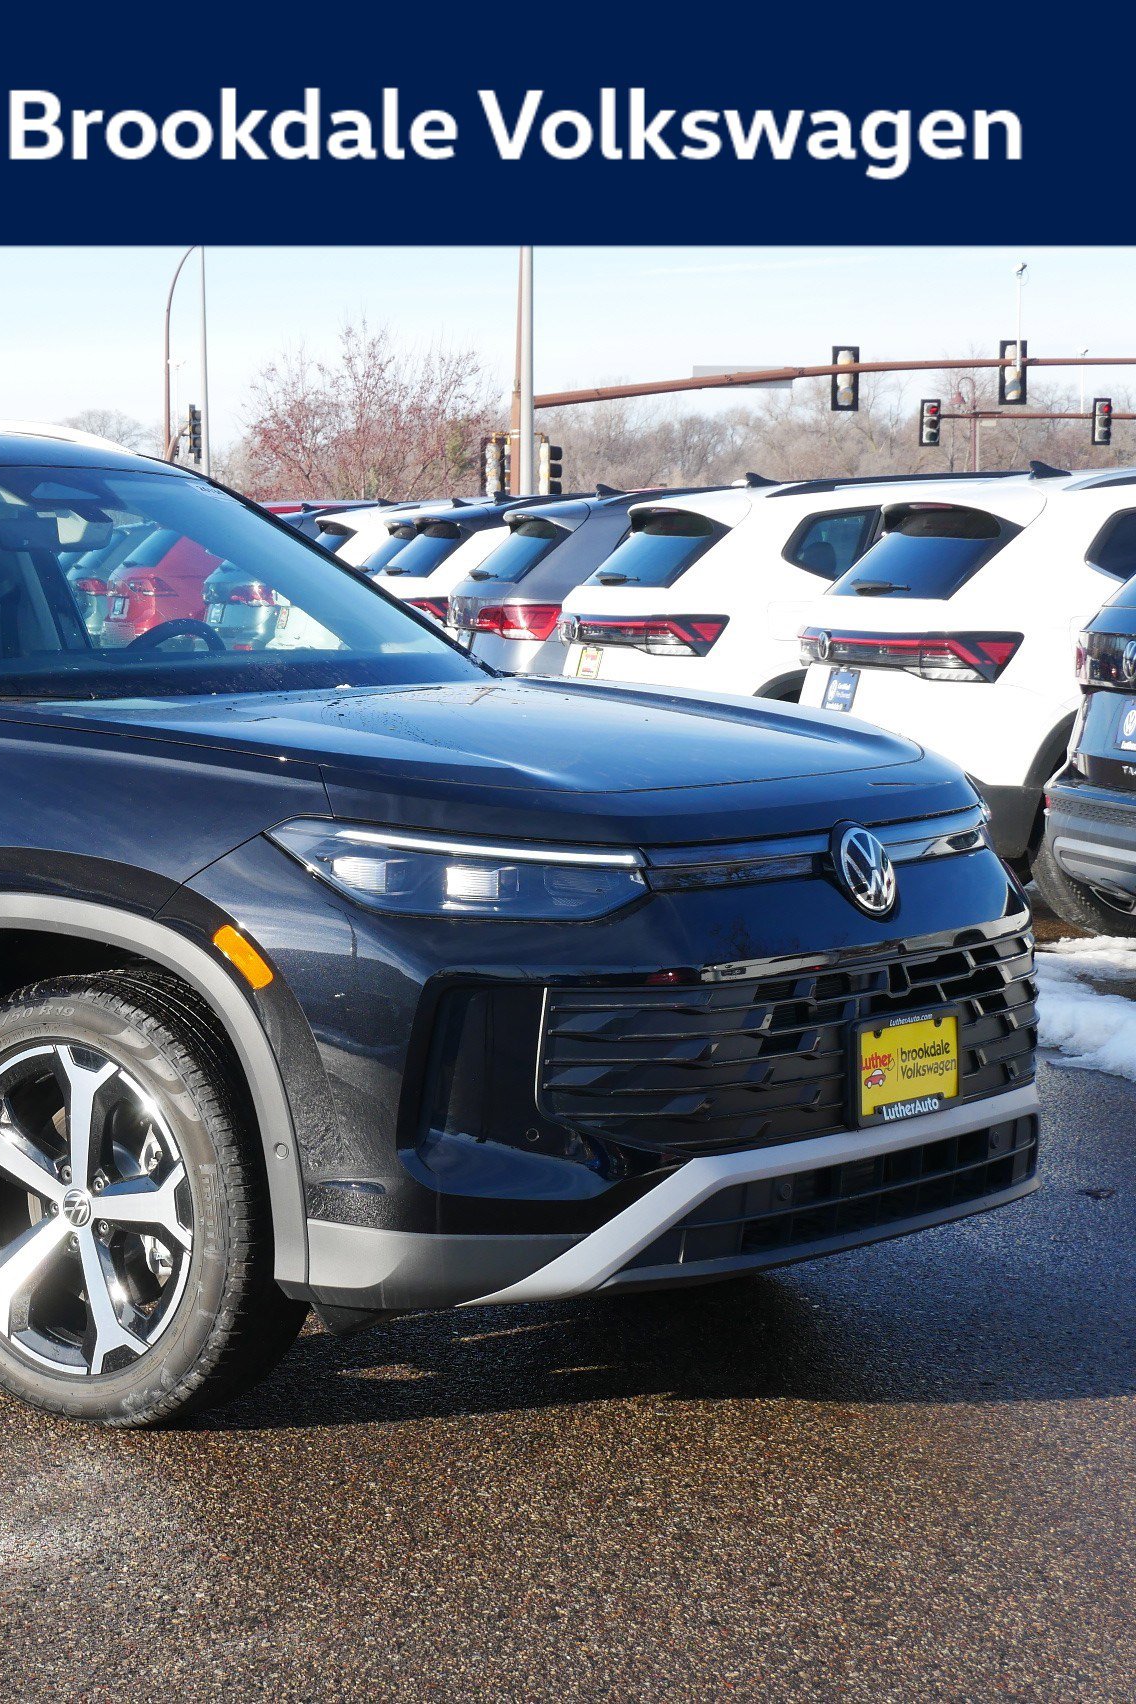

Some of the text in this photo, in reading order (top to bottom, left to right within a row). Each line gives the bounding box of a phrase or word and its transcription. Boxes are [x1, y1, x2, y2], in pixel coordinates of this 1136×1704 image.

[889, 1013, 933, 1026] LutherAuto.com
[861, 1052, 892, 1071] Luther
[900, 1039, 951, 1062] brookdale
[900, 1058, 957, 1080] Volkswagen
[883, 1098, 939, 1120] LutherAuto
